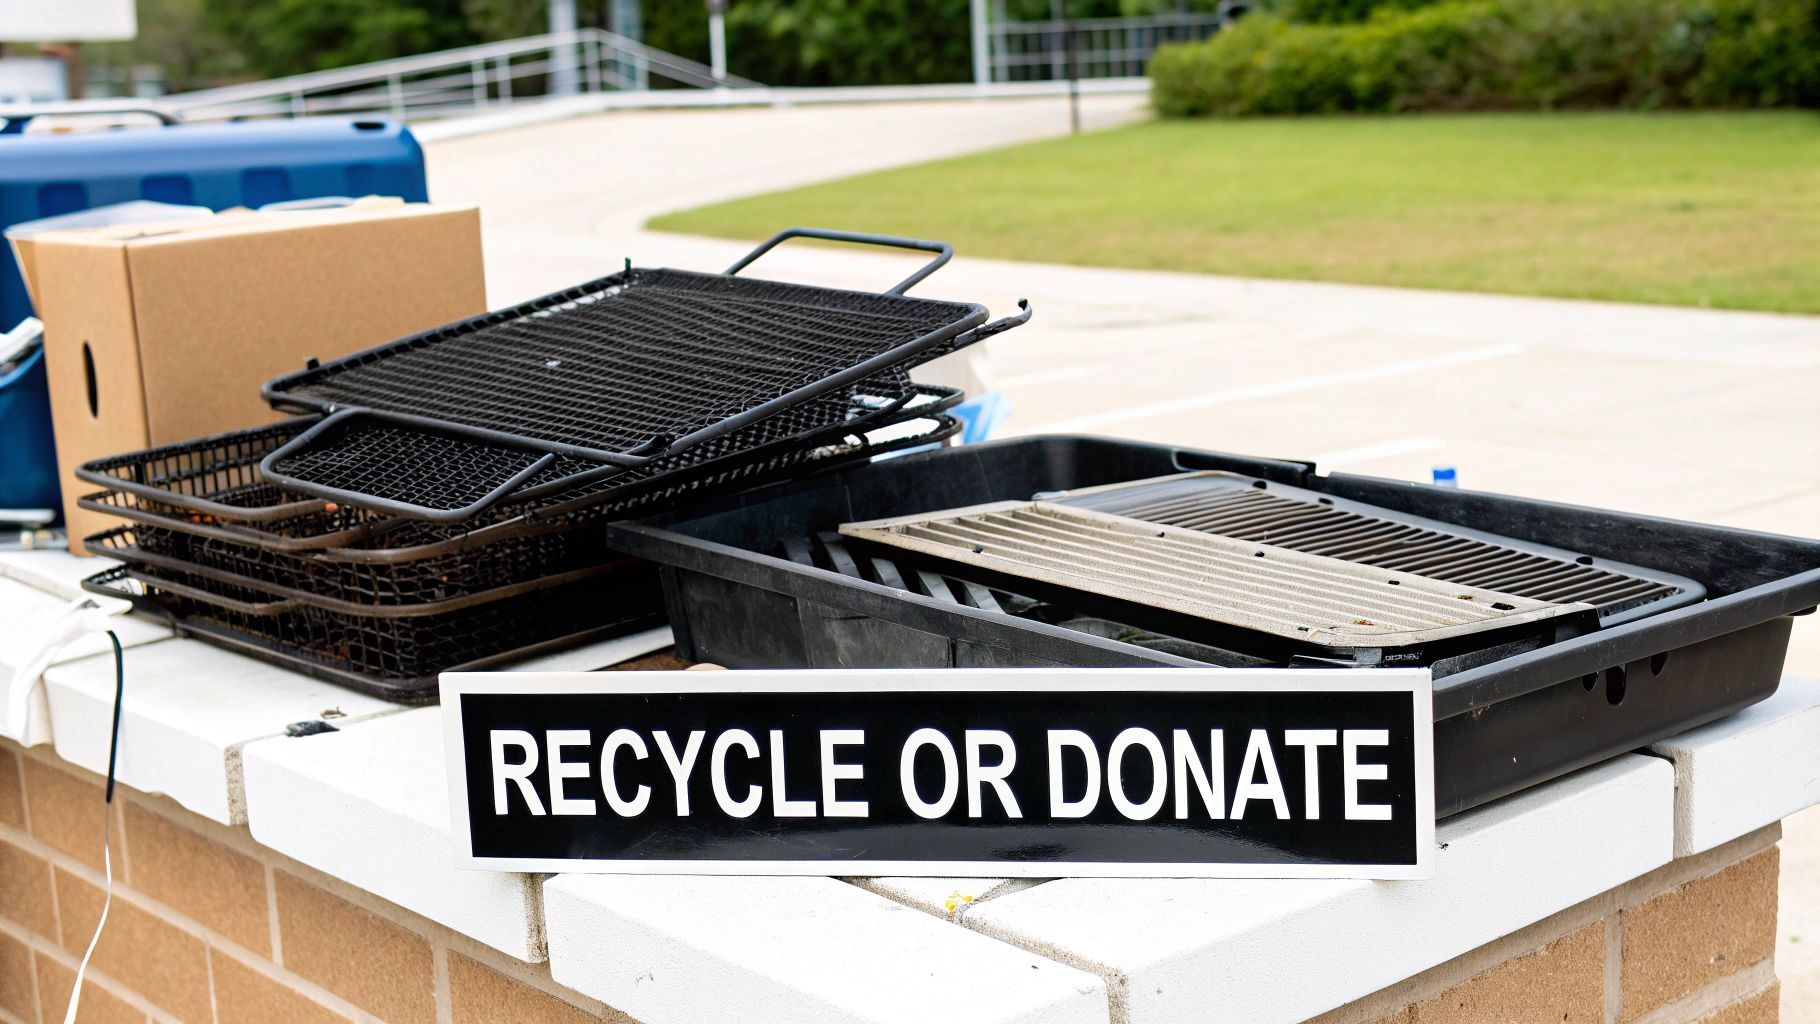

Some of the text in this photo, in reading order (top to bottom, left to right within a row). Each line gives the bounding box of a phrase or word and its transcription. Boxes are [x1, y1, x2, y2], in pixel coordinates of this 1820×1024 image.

[490, 728, 1392, 820] RECYCLE OR DONATE
